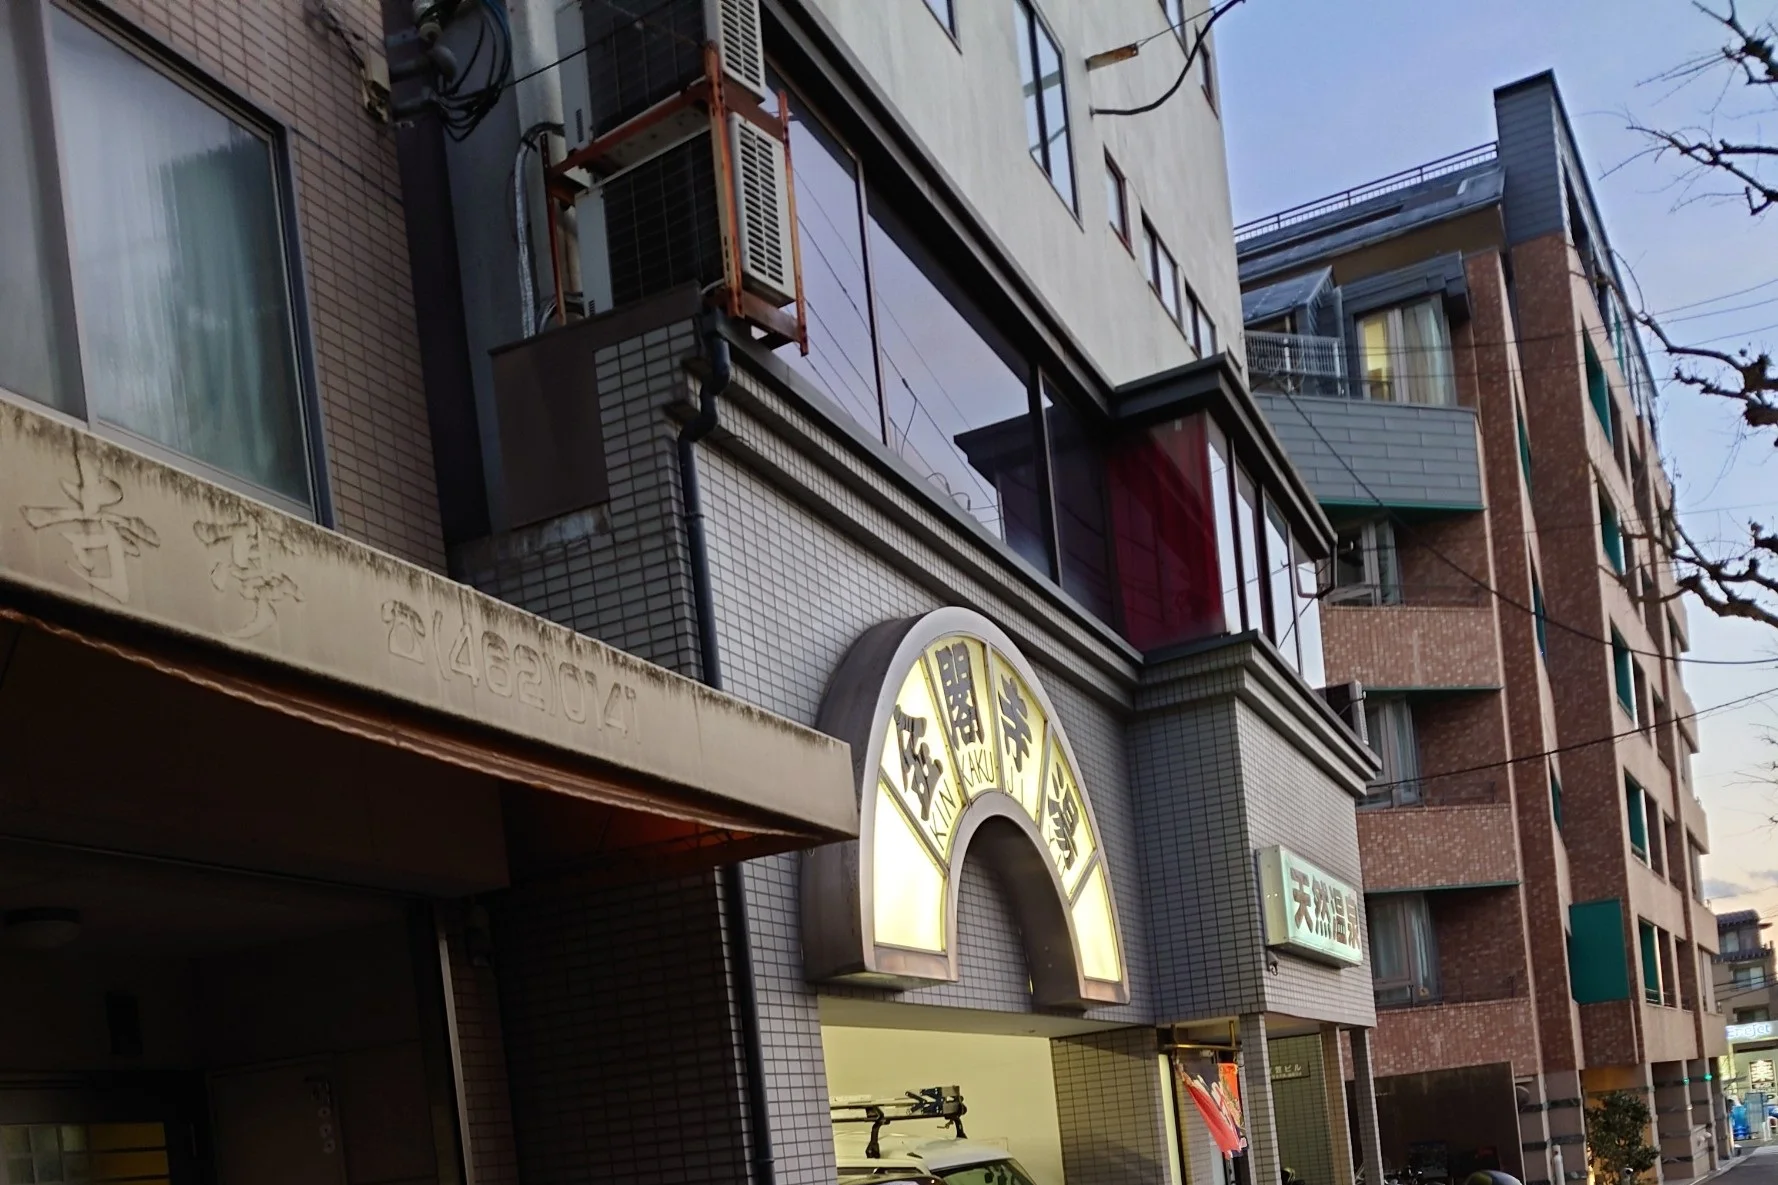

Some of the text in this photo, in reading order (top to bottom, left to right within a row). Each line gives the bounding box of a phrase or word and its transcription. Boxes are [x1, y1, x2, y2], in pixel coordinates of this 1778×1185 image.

[929, 779, 956, 851] KIN
[960, 749, 995, 788] KAKU
[1289, 867, 1361, 950] 天然温泉
